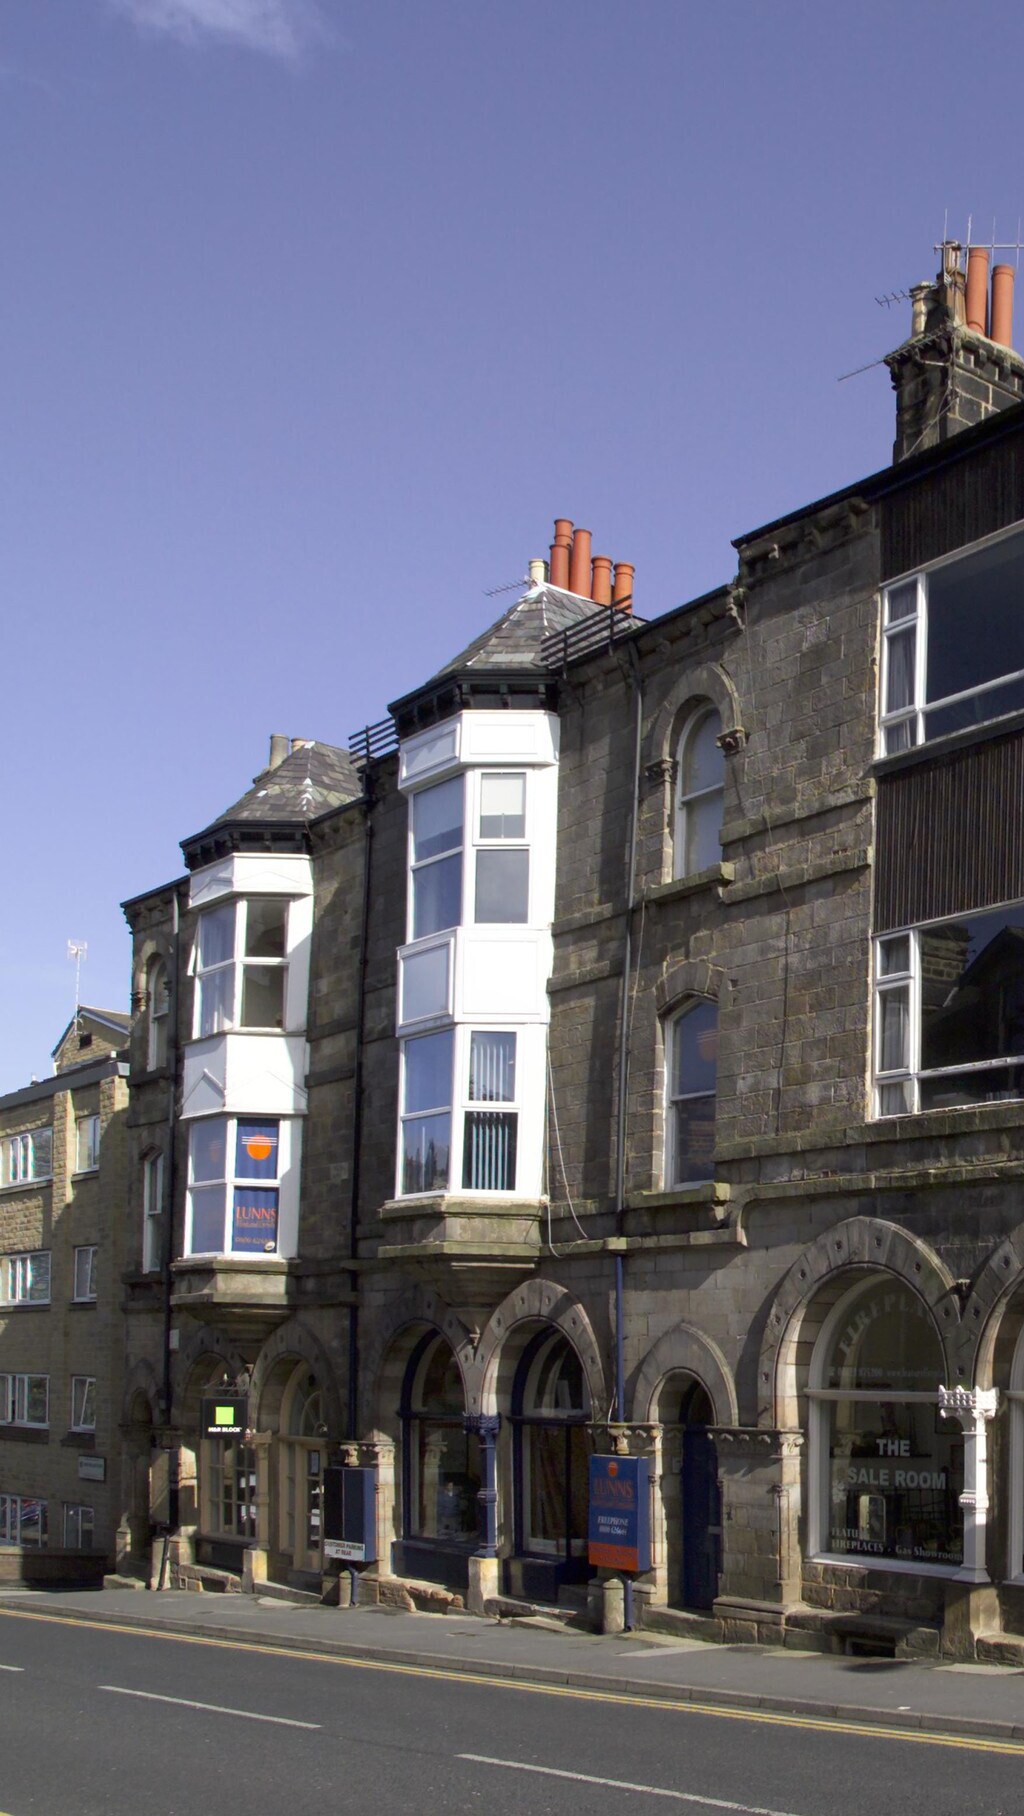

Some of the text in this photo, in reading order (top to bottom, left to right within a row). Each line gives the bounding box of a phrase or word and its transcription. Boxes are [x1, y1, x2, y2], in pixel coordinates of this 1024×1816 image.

[876, 1438, 910, 1457] THE
[848, 1467, 946, 1489] SALE ROOM
[895, 1545, 912, 1554] Gas
[913, 1546, 963, 1560] Showroom
